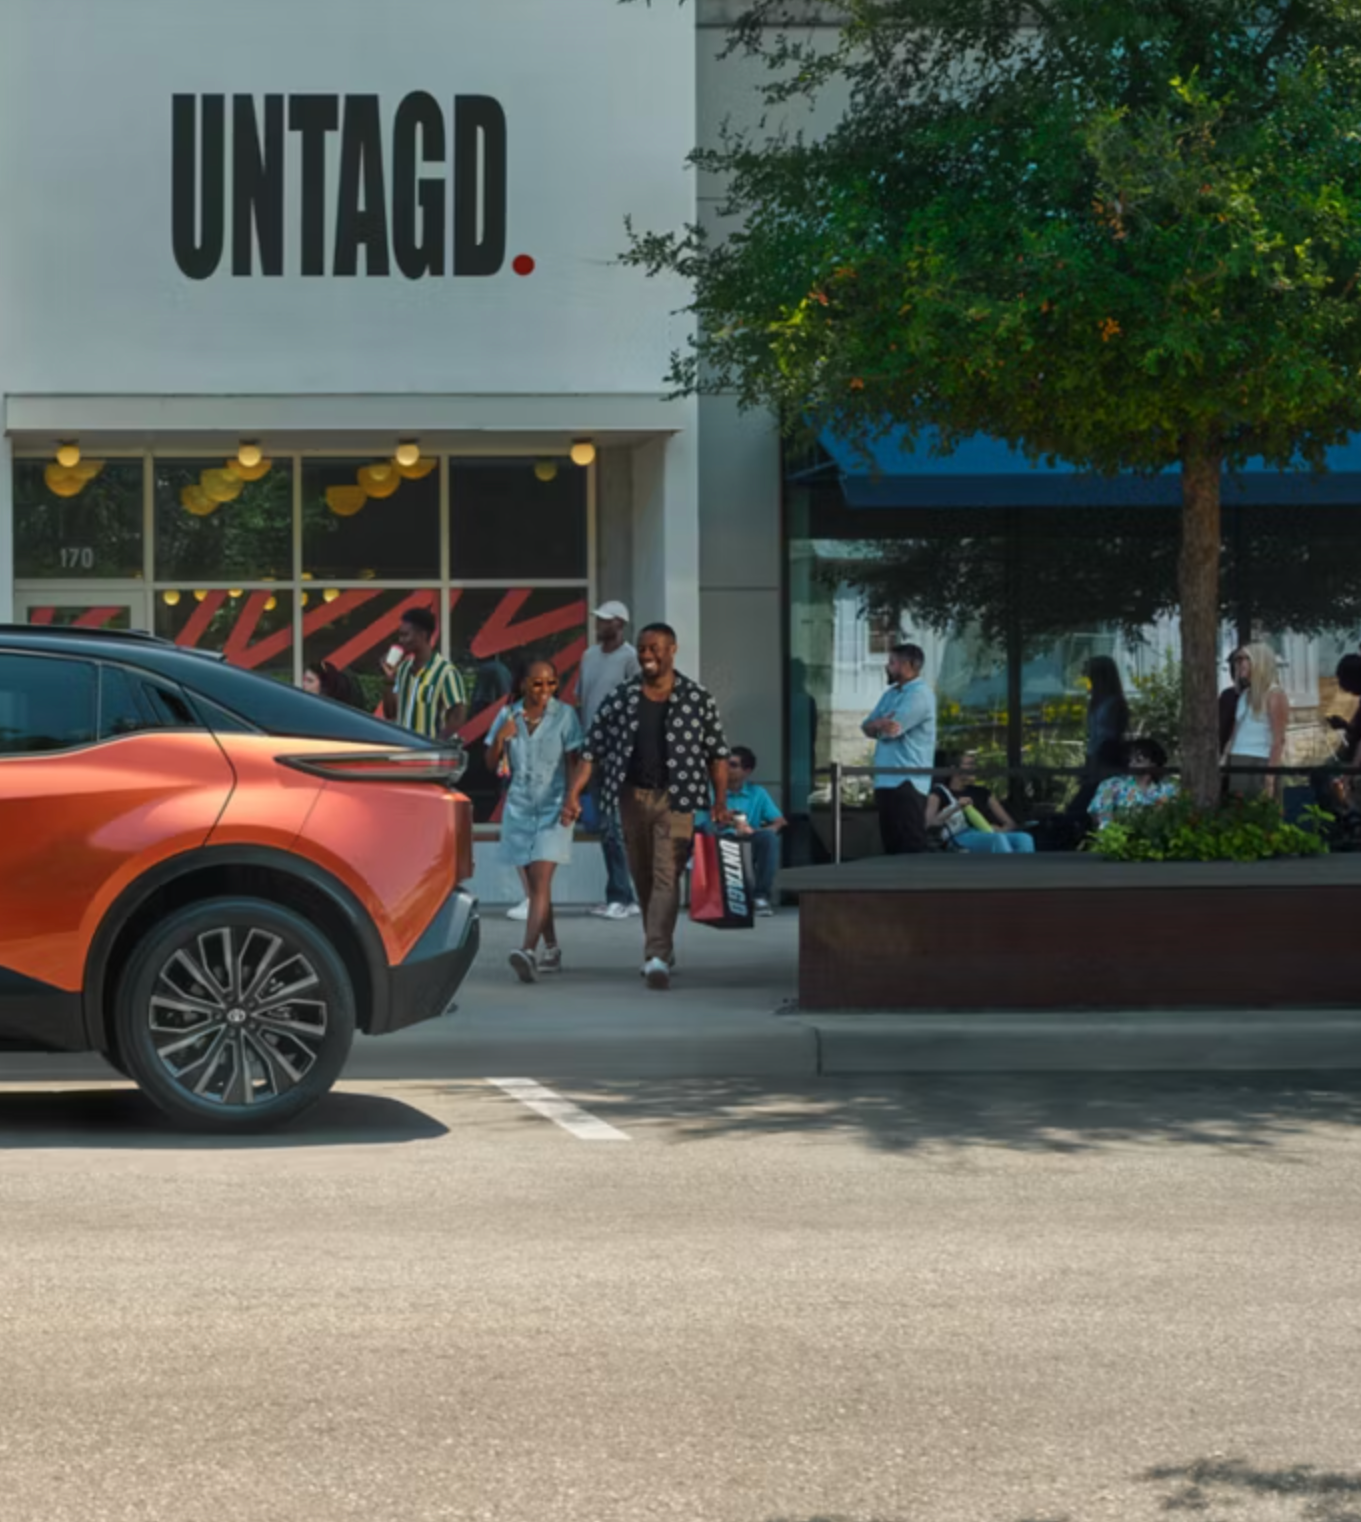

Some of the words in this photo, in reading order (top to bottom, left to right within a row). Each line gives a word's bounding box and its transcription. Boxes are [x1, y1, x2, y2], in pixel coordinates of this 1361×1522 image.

[171, 90, 535, 280] UNTAGD.
[60, 547, 94, 569] 170
[719, 839, 748, 916] UNTAGD
